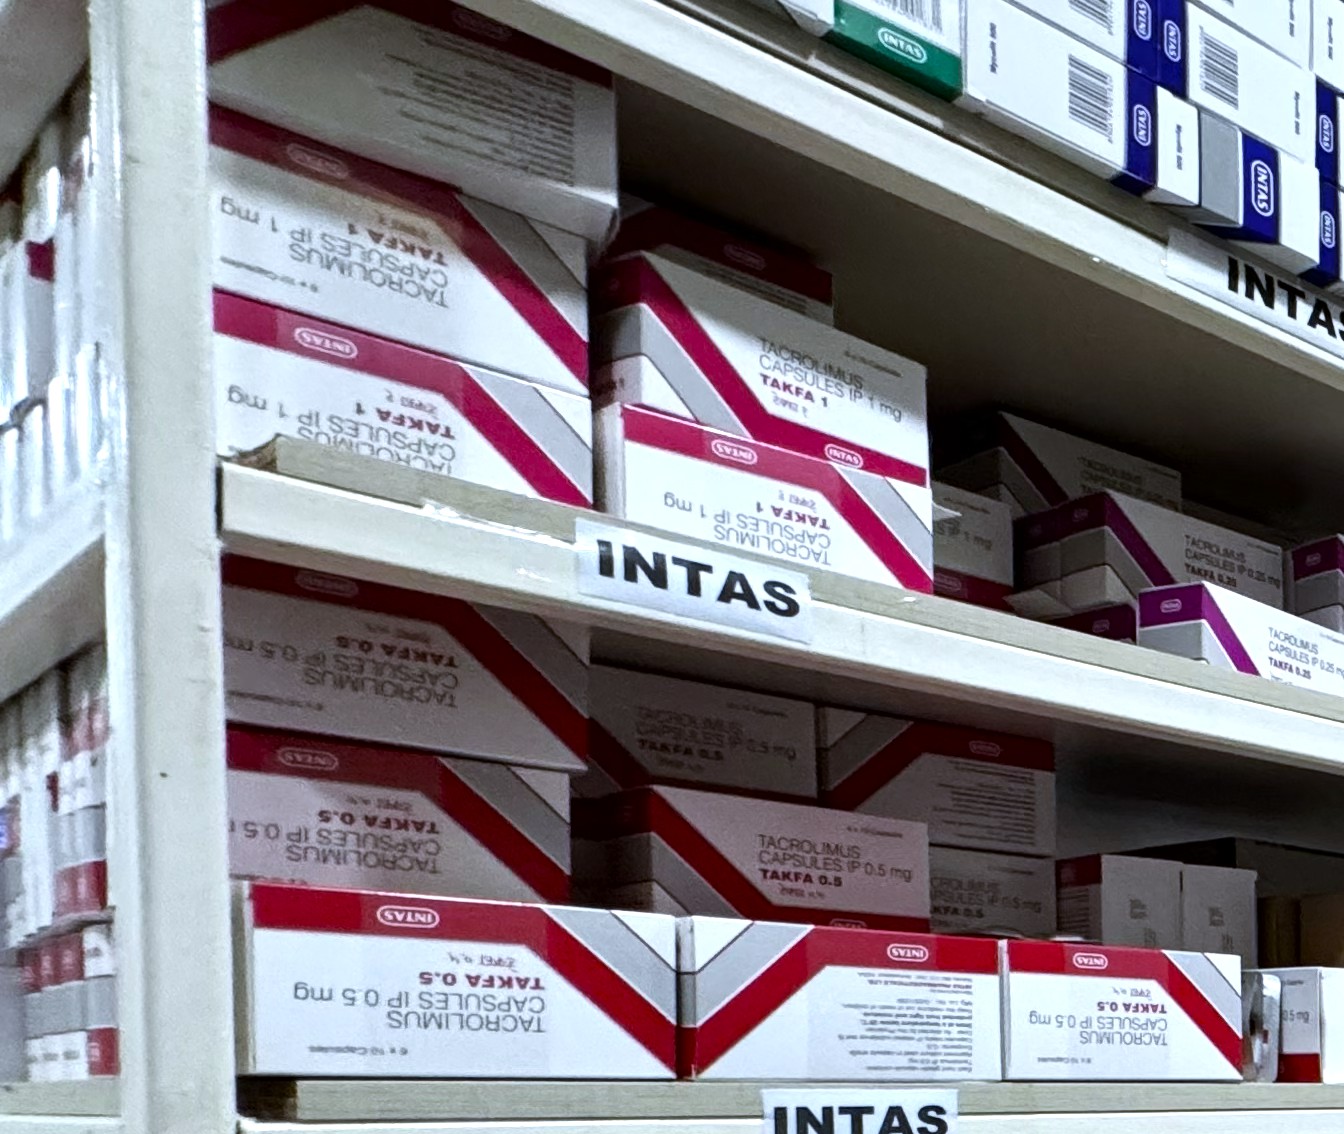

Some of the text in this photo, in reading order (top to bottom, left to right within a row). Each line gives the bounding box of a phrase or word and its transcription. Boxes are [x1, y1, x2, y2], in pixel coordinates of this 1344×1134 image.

[882, 32, 924, 61] INTAS
[1254, 168, 1270, 210] INTAS
[221, 196, 259, 223] mg
[290, 244, 448, 308] TACROLIMUS
[761, 338, 863, 389] TACROLIMUS
[759, 355, 843, 397] CAPSULES
[879, 402, 902, 422] mg
[761, 374, 815, 404] TAKFA
[228, 385, 456, 462] CAPSULES IP mg
[377, 408, 455, 440] TAKFA
[716, 444, 752, 461] INTAS
[829, 448, 860, 464] INTAS
[664, 493, 831, 548] CAPSULES IP mg
[771, 507, 830, 530] TAKFA
[714, 526, 831, 564] TACROLIMUS
[596, 540, 799, 617] INTAS
[1268, 627, 1319, 654] TACROLIMUS
[304, 667, 457, 708] TACROLIMUS
[366, 816, 439, 834] TAKFA
[318, 830, 440, 856] CAPSULES
[758, 835, 860, 859] TACROLIMUS
[286, 847, 441, 874] TACROLIMUS
[758, 850, 842, 872] CAPSULES
[759, 869, 813, 884] TAKFA
[383, 910, 434, 924] INTAS
[891, 948, 924, 958] INTAS
[1076, 956, 1104, 966] INTAS
[419, 972, 544, 990] TAKFA 0.5
[294, 982, 545, 1012] CAPSULES IP 0.5 mg
[1097, 1001, 1167, 1014] TAKFA 0.5
[387, 1012, 545, 1032] TACROLIMUS
[1030, 1011, 1168, 1031] CAPSULES IP 0.5 mg
[1080, 1031, 1168, 1046] TACROLIMUS
